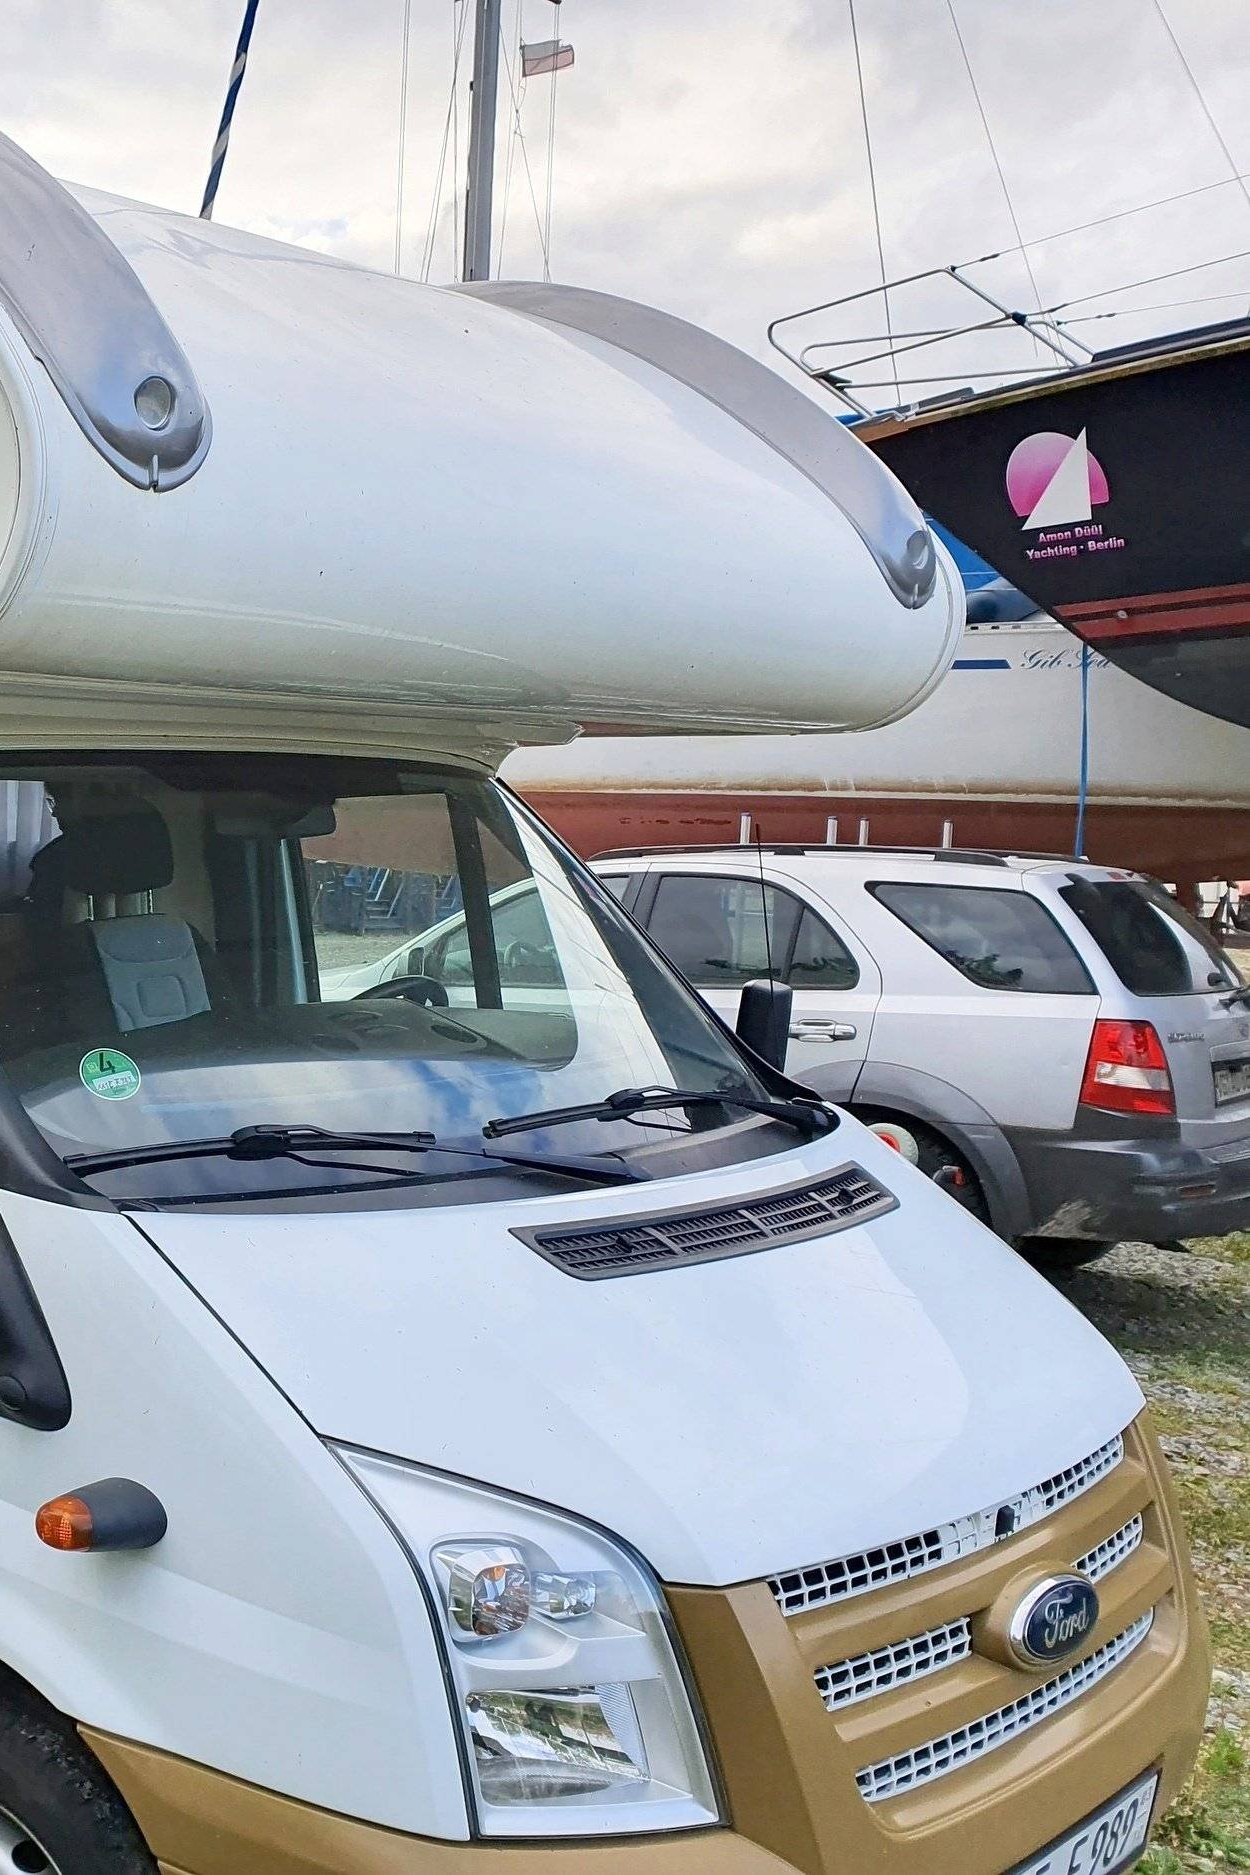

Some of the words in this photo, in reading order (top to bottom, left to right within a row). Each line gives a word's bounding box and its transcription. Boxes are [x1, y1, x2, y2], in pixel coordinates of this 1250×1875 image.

[1038, 529, 1072, 543] Amon
[1025, 544, 1078, 560] Yachting
[1087, 536, 1125, 551] Berlin
[98, 1052, 116, 1074] 4
[1044, 1593, 1090, 1649] Ford
